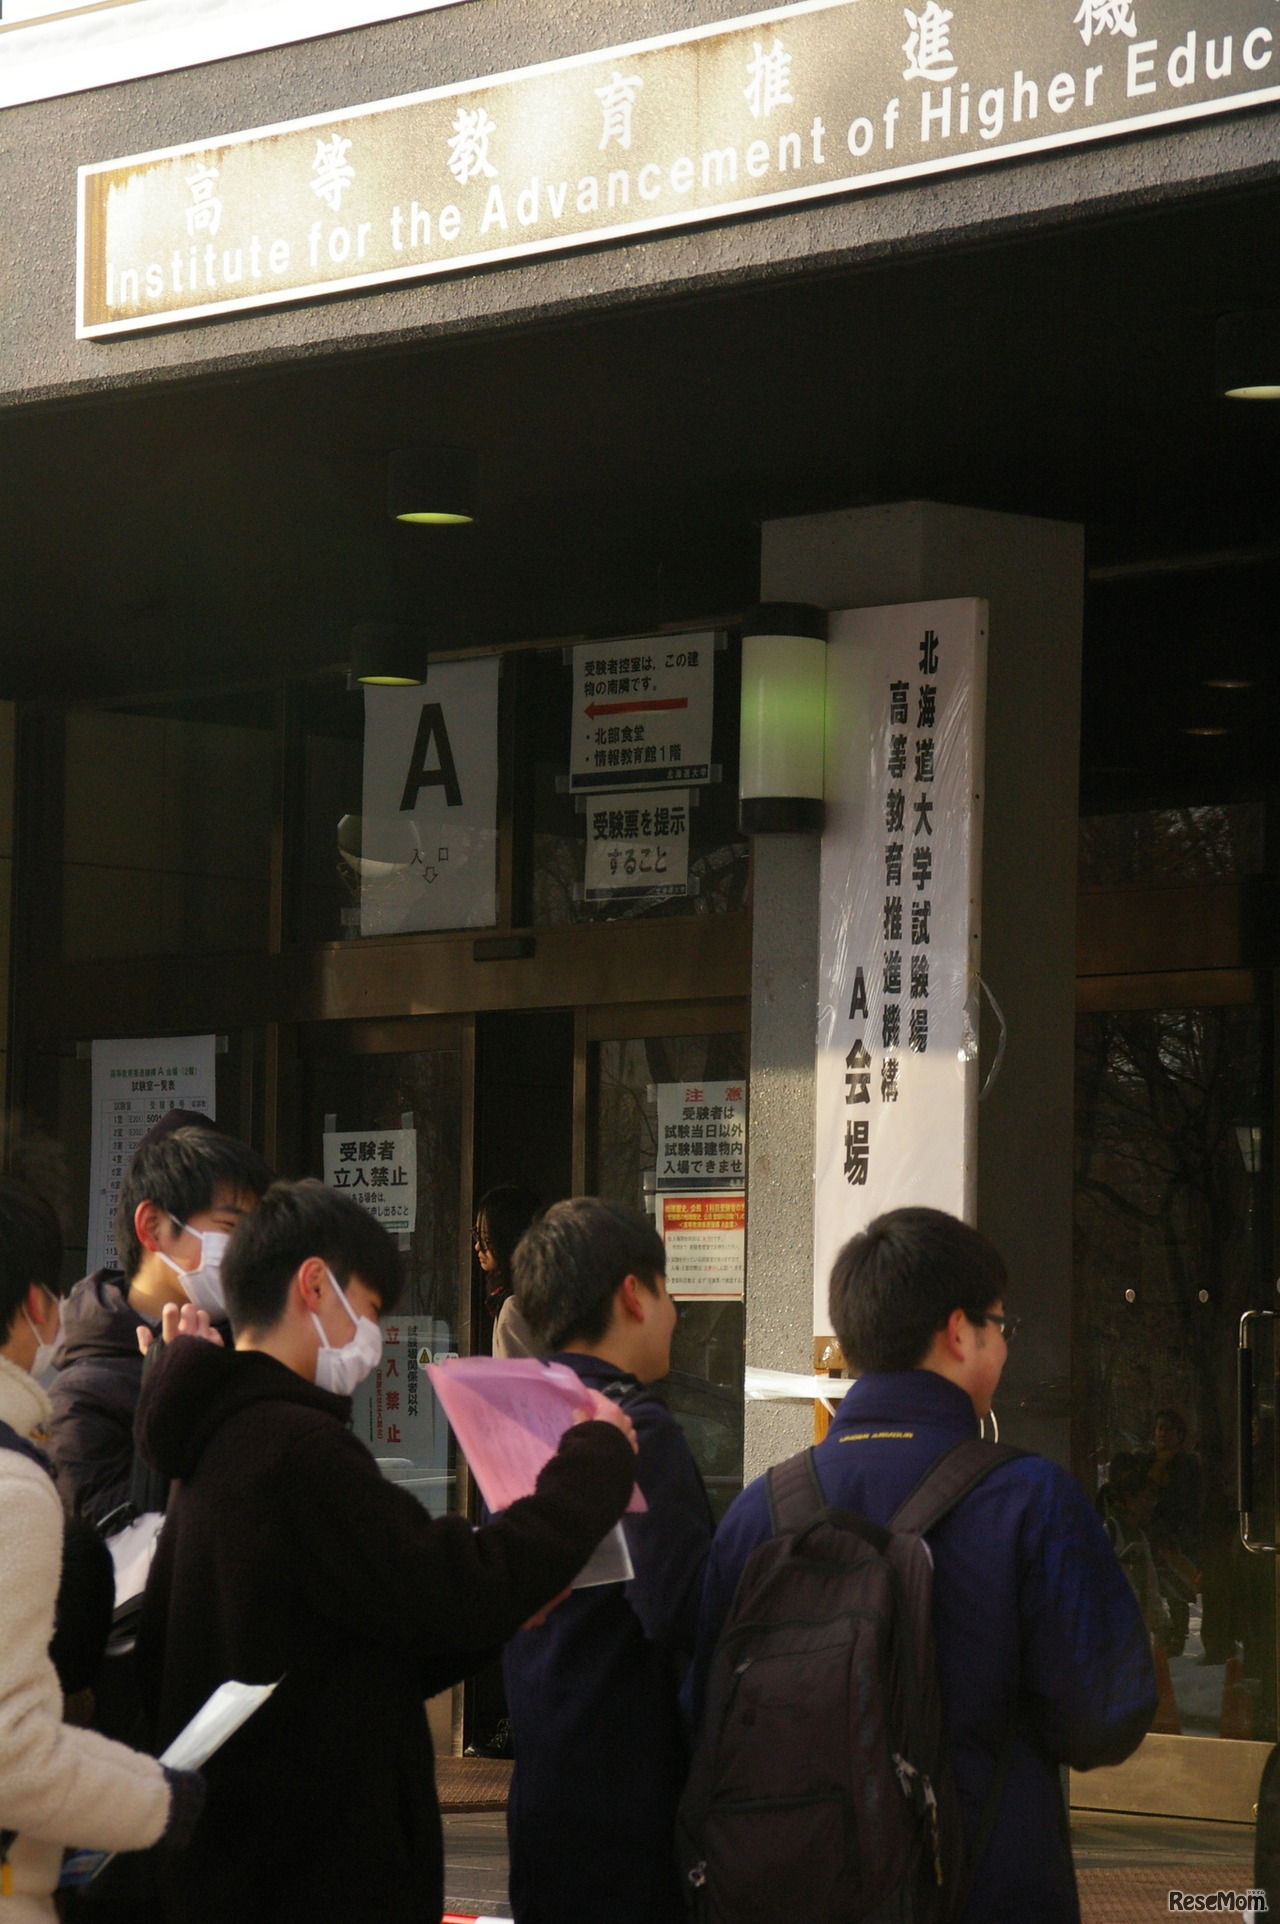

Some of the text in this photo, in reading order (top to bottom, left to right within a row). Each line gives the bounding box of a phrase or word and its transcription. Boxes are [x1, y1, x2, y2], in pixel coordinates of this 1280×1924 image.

[106, 27, 1273, 303] Institute for the Advancement of Higher Educ
[399, 702, 463, 811] A
[593, 806, 686, 842] 受験票を提示
[908, 630, 939, 1054] 北海道大学試験場
[411, 848, 449, 866] 入口
[607, 848, 668, 876] すること
[881, 680, 909, 1103] 高等教育推進機構
[131, 1080, 176, 1092] 試験室一覧表
[843, 965, 872, 1187] A会場
[685, 1086, 742, 1103] 注意
[682, 1106, 735, 1121] 受験者は
[664, 1123, 743, 1139] 試験当日以外
[339, 1140, 395, 1162] 受験者
[664, 1142, 743, 1157] 試験場建物内
[333, 1166, 408, 1188] 立入禁止
[663, 1160, 743, 1174] 入場できませ
[386, 1326, 401, 1443] 立入禁止
